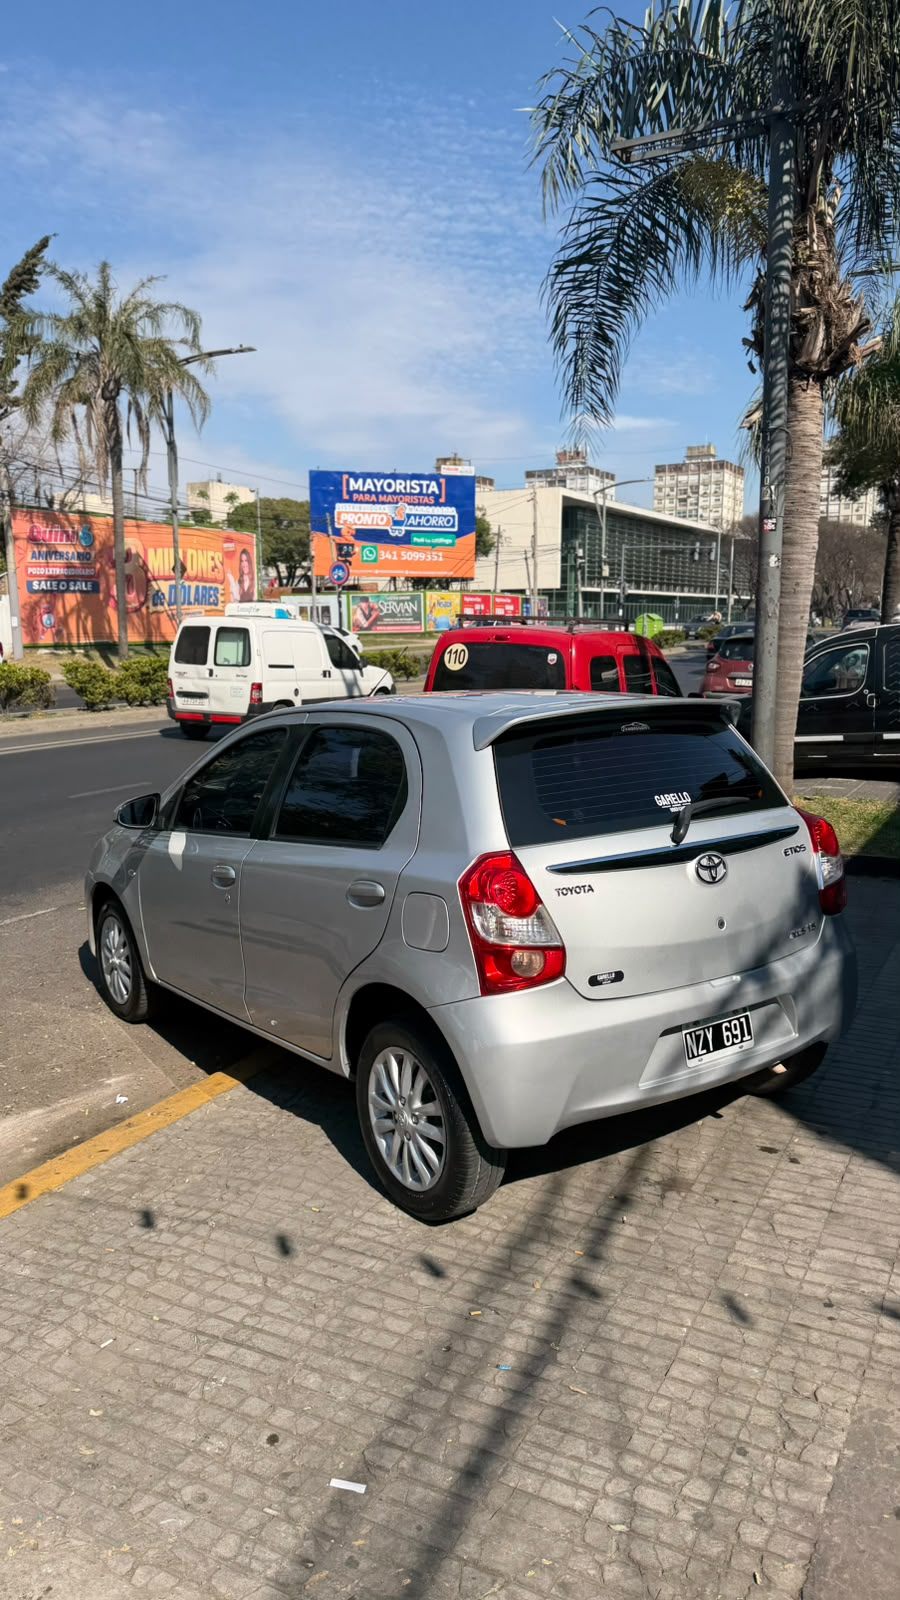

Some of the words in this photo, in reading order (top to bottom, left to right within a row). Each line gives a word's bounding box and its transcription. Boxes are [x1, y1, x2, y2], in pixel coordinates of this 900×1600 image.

[349, 478, 439, 494] MAYORISTA
[353, 493, 377, 502] PARA
[379, 494, 435, 504] MAYORISTAS
[340, 513, 388, 526] PRONTO
[406, 515, 454, 527] AHORRO
[31, 550, 92, 561] ANIVERSARIO
[379, 550, 398, 561] 341
[401, 551, 443, 562] 5099351
[32, 580, 58, 591] SALE
[59, 581, 68, 591] O
[68, 581, 93, 591] SALE
[446, 648, 466, 665] 110
[654, 791, 691, 806] GARELLO
[783, 844, 806, 857] ETIOS
[555, 884, 594, 897] TOYOTA
[686, 1026, 713, 1058] NZY
[721, 1016, 751, 1047] 691
